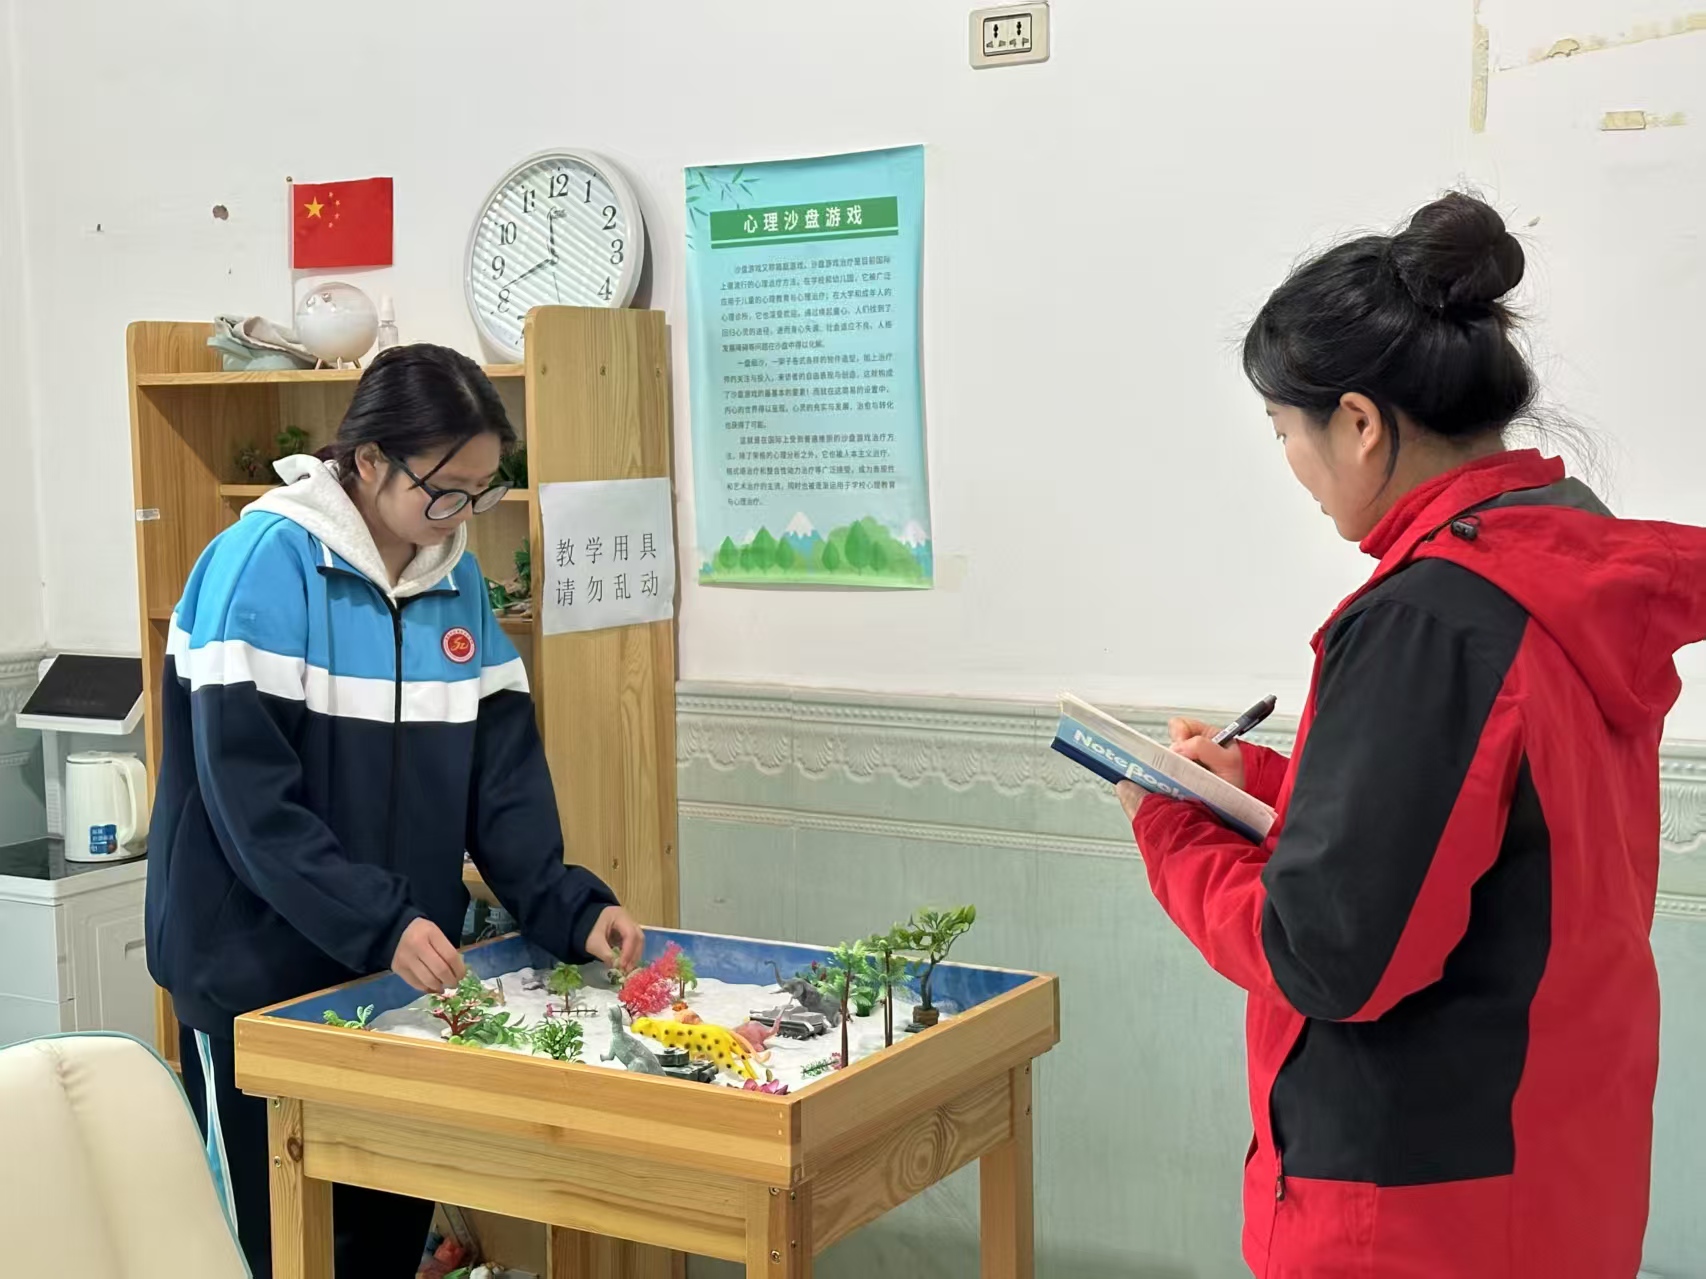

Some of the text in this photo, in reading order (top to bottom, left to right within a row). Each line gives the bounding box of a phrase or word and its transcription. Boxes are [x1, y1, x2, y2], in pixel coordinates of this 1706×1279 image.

[548, 173, 569, 198] 12
[584, 179, 591, 203] 1
[602, 205, 617, 230] 2
[743, 204, 863, 234] 心理沙盘游戏
[498, 221, 517, 246] 10
[610, 239, 624, 265] 3
[491, 256, 506, 281] 9
[497, 288, 511, 314] 8
[597, 276, 613, 301] 4
[556, 533, 656, 567] 教学用具
[556, 571, 659, 606] 请勿乱动
